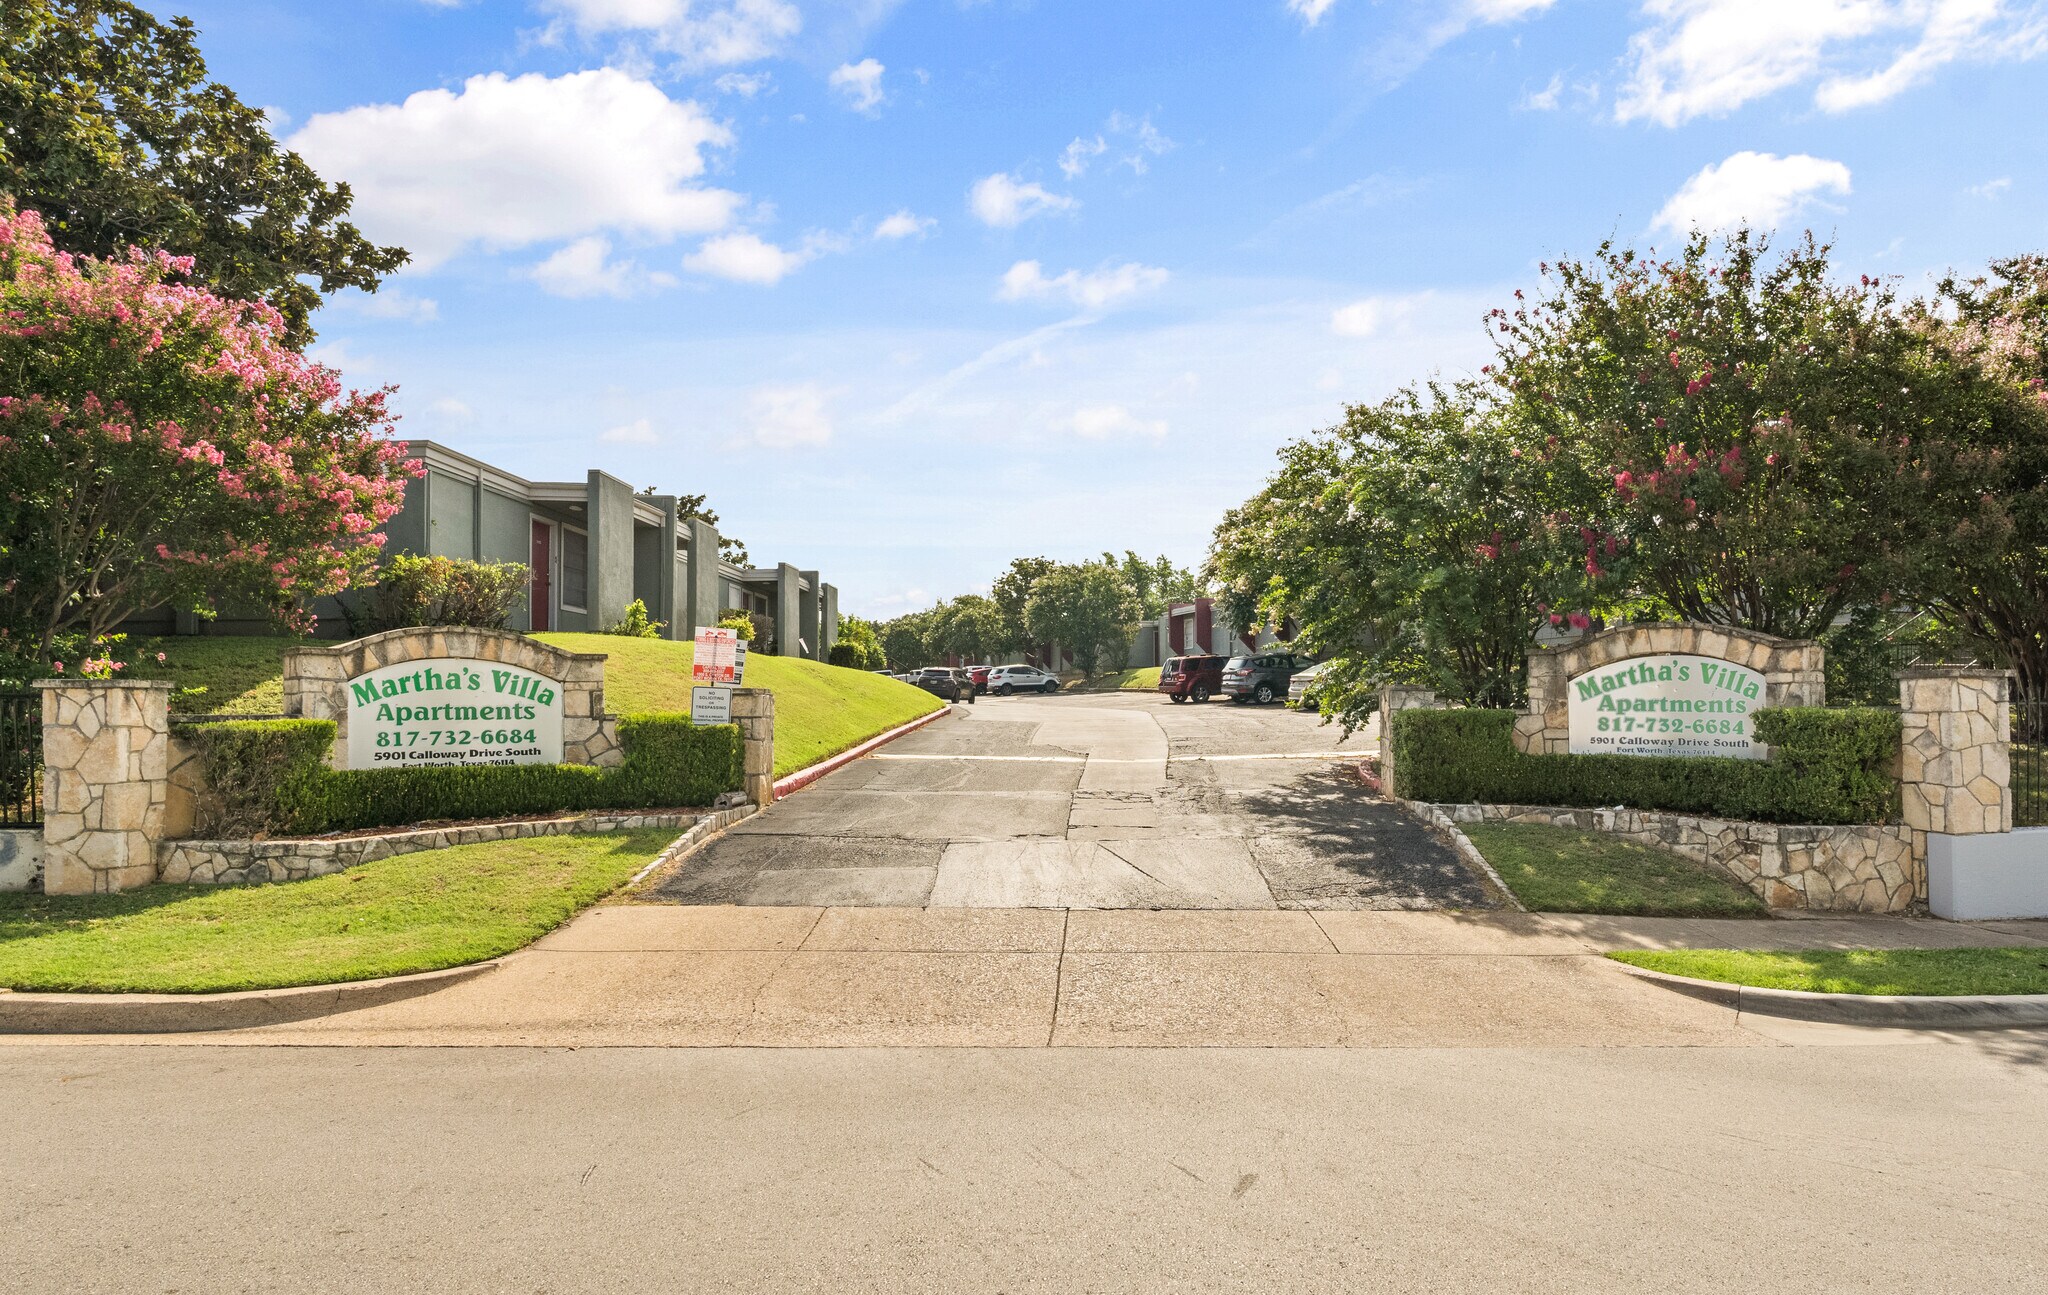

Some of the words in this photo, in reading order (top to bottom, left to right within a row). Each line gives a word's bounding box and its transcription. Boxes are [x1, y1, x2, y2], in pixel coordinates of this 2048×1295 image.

[350, 666, 481, 708] Martha's
[491, 669, 555, 707] Villa
[1575, 660, 1691, 703] Martha's
[1700, 662, 1760, 700] Villa
[376, 703, 535, 726] Apartments
[1597, 694, 1747, 716] Apartments
[1597, 716, 1745, 735] 817-732-6684
[376, 728, 537, 747] 817-732-6684
[1590, 736, 1615, 745] 5901
[1619, 736, 1674, 748] Calloway
[1677, 738, 1710, 747] Drive
[1713, 739, 1749, 748] South
[374, 752, 406, 761] 5901
[408, 750, 466, 760] Calloway
[469, 748, 503, 758] Drive
[505, 747, 542, 756] South
